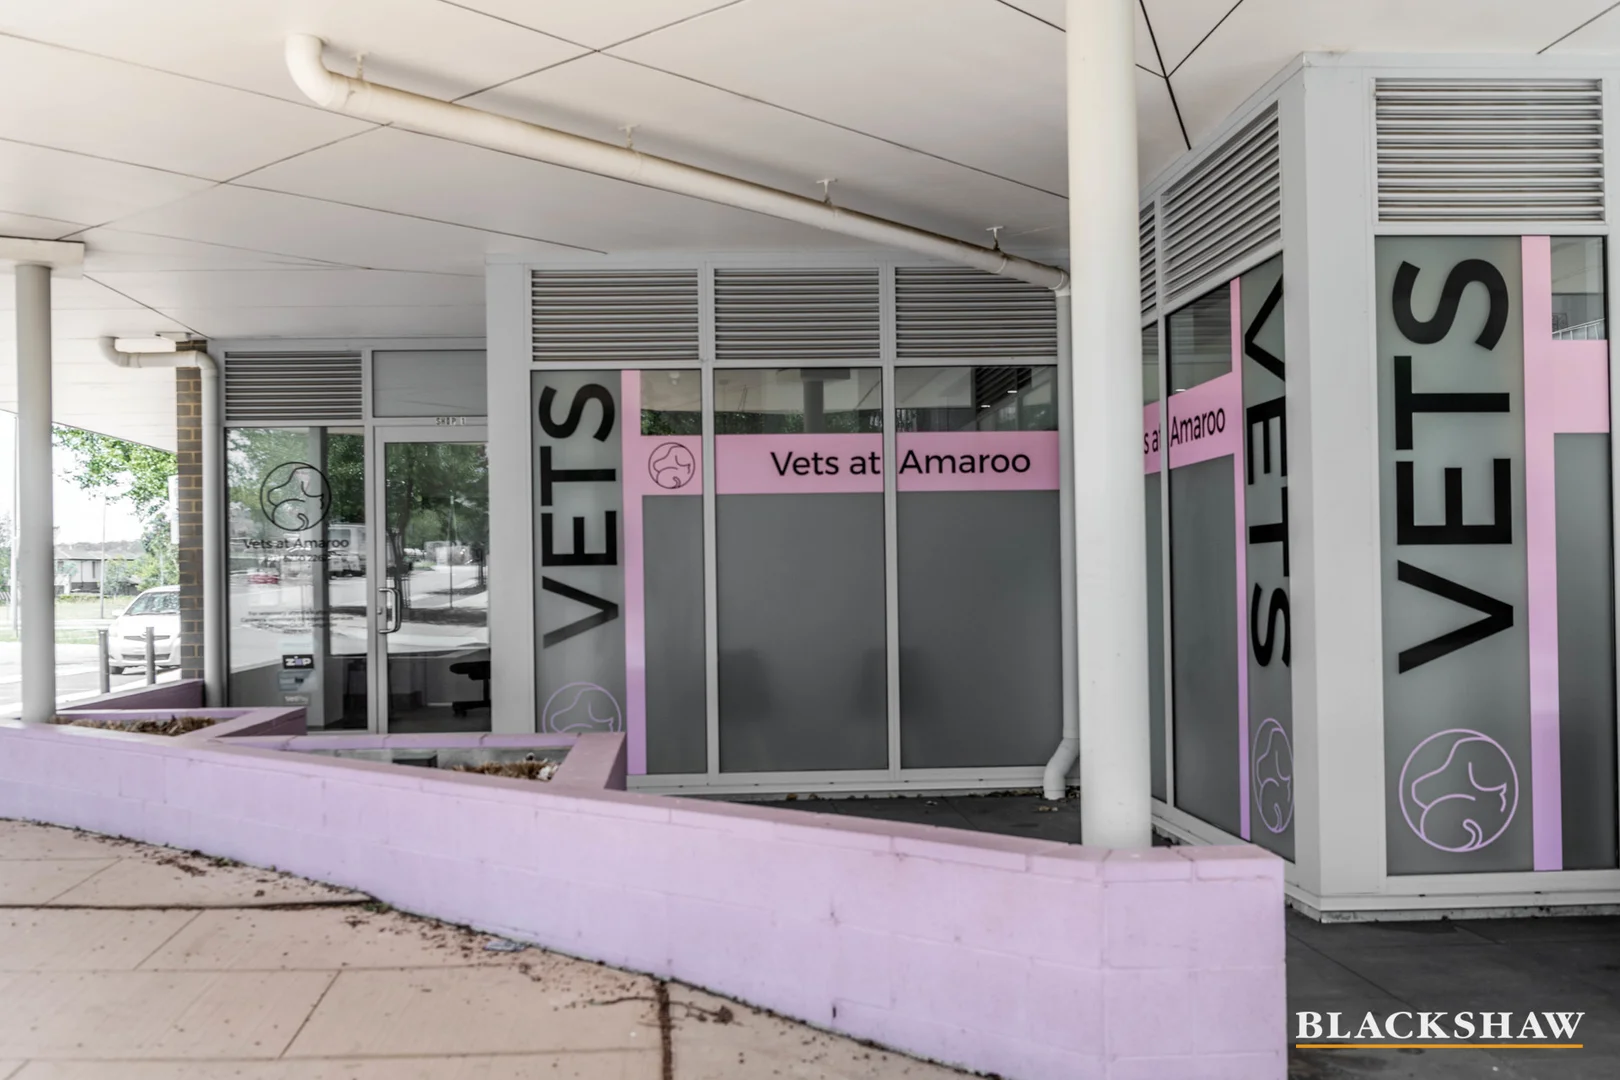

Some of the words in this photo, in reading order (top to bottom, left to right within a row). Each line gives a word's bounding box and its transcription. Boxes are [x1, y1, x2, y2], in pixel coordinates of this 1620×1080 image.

[770, 451, 840, 476] Vets
[849, 451, 881, 475] at
[898, 449, 1031, 474] Amaroo
[1169, 408, 1226, 447] Amaroo
[1244, 273, 1292, 667] VETS
[1392, 258, 1514, 674] VETS
[243, 538, 273, 549] Vets
[294, 538, 350, 549] Amaroo
[538, 383, 619, 649] VETS
